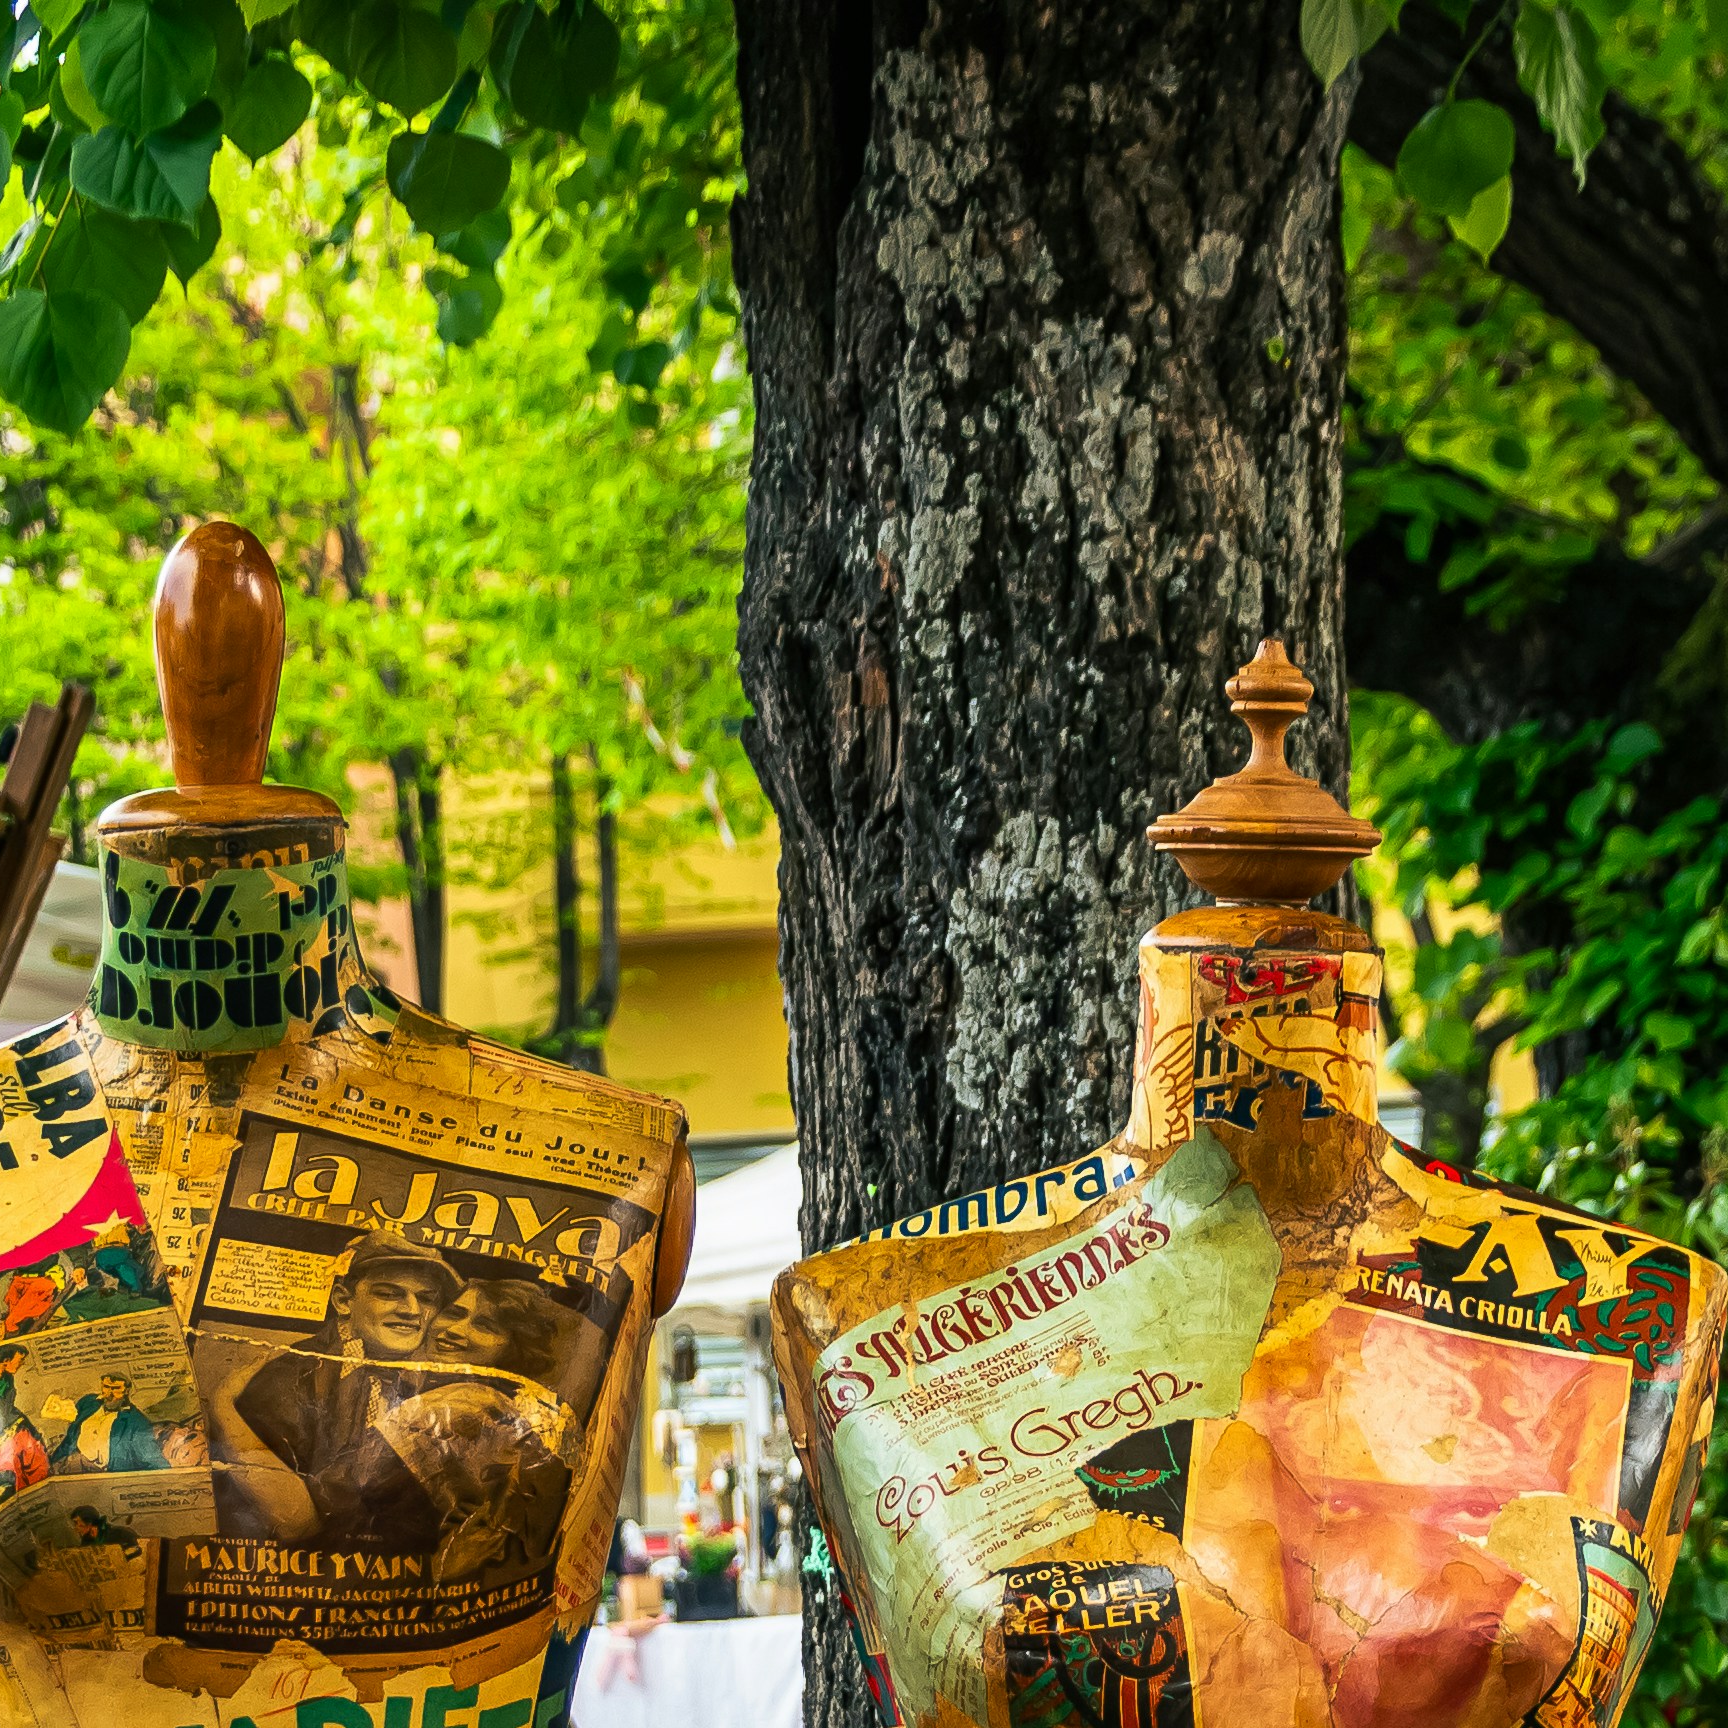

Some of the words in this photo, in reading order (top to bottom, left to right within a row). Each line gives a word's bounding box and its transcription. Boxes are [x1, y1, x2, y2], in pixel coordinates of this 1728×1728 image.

[9, 1020, 110, 1159] ALBA
[280, 1064, 319, 1091] La
[343, 1083, 459, 1130] Danse
[479, 1123, 522, 1144] du
[544, 1135, 647, 1172] Jour!
[411, 1126, 445, 1140] pour
[455, 1135, 496, 1151] Piano
[504, 1148, 534, 1159] seul
[543, 1154, 576, 1167] avec
[262, 1131, 362, 1206] la
[371, 1171, 622, 1261] Java
[172, 1207, 186, 1220] 26
[346, 1209, 406, 1239] PAR
[167, 1235, 181, 1249] 25
[1459, 1295, 1573, 1338] CRIOLLA
[978, 1358, 1019, 1383] SOIR
[184, 1541, 326, 1578] MAURICE
[330, 1551, 423, 1580] YVAIN
[184, 1581, 242, 1596] ALBERT
[1009, 1566, 1063, 1590] Gros
[1051, 1573, 1087, 1589] de
[186, 1600, 305, 1623] EDITIONS
[315, 1604, 422, 1624] FRANCIS
[432, 1577, 540, 1619] SALABERT
